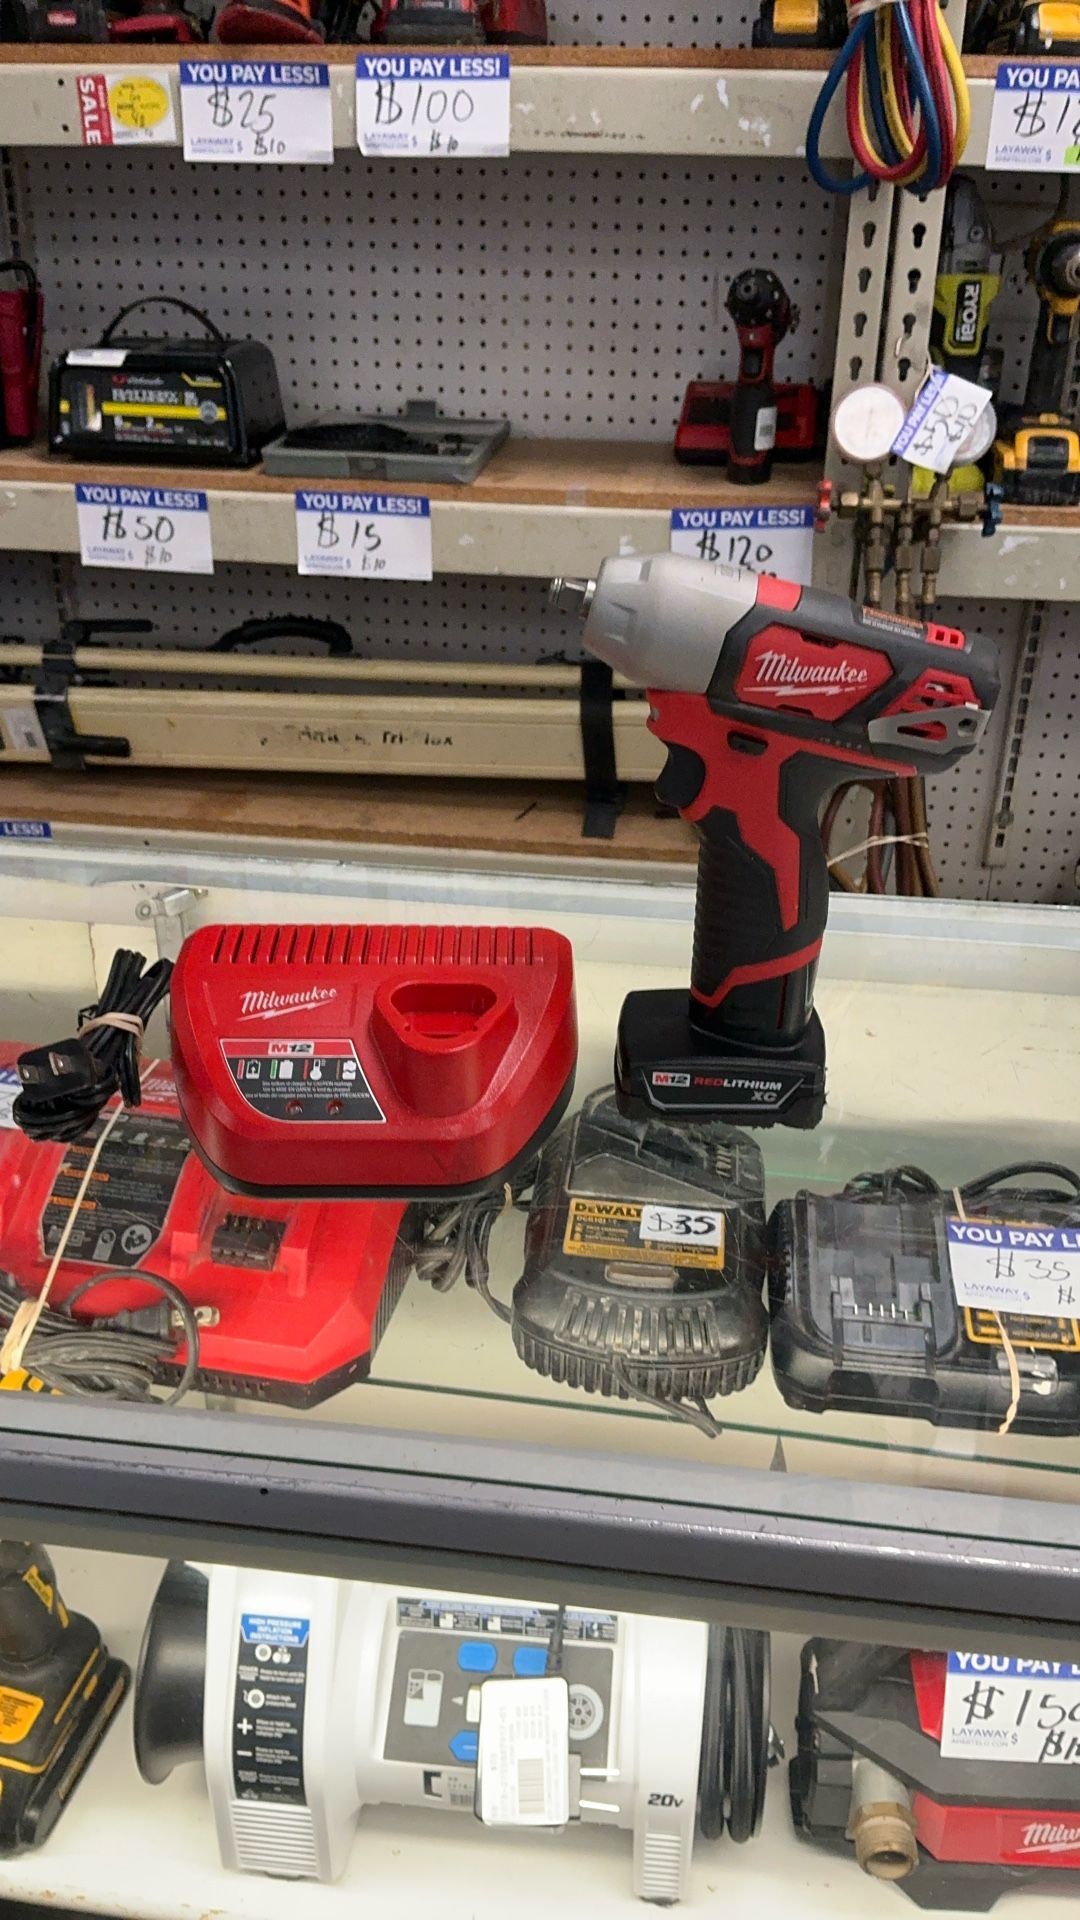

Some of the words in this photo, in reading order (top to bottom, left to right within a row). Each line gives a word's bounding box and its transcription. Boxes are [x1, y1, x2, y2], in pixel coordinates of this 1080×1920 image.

[187, 64, 227, 83] YOU
[231, 64, 266, 83] PAY
[270, 65, 320, 84] LESS!
[365, 58, 405, 77] YOU
[410, 58, 446, 77] PAY
[450, 58, 500, 76] LESS!
[1006, 67, 1050, 88] YOU
[1054, 68, 1080, 89] PA
[80, 78, 102, 144] SALE
[208, 82, 277, 134] $25
[375, 79, 474, 125] $100
[1013, 89, 1080, 146] $1
[995, 145, 1043, 155] LAYAWAY
[893, 425, 915, 454] YOU
[81, 485, 118, 503] YOU
[120, 488, 151, 506] PAY
[154, 490, 200, 509] LESS!
[302, 493, 339, 510] YOU
[342, 495, 374, 511] PAY
[377, 497, 422, 515] LESS!
[102, 505, 174, 543] $50
[680, 511, 717, 527] YOU
[721, 510, 753, 527] PAY
[757, 509, 806, 526] LESS!
[318, 510, 382, 552] $15
[696, 529, 773, 566] $120
[754, 649, 868, 684] Milwaukee
[240, 985, 337, 1015] Milwaukee
[271, 1043, 313, 1053] M12
[655, 1074, 689, 1085] M12
[693, 1076, 783, 1091] REDLITHIUM
[750, 1090, 778, 1102] XC
[647, 1212, 716, 1235] $35
[950, 1225, 1003, 1245] YOU
[1009, 1231, 1054, 1248] PAY
[986, 1248, 1071, 1282] $35
[964, 1282, 1019, 1295] LAYAWAY
[1023, 1291, 1030, 1301] $
[956, 1651, 1009, 1672] YOU
[1016, 1658, 1061, 1675] PAY
[952, 1727, 1009, 1739] LAYAWAY
[1011, 1732, 1018, 1745] $
